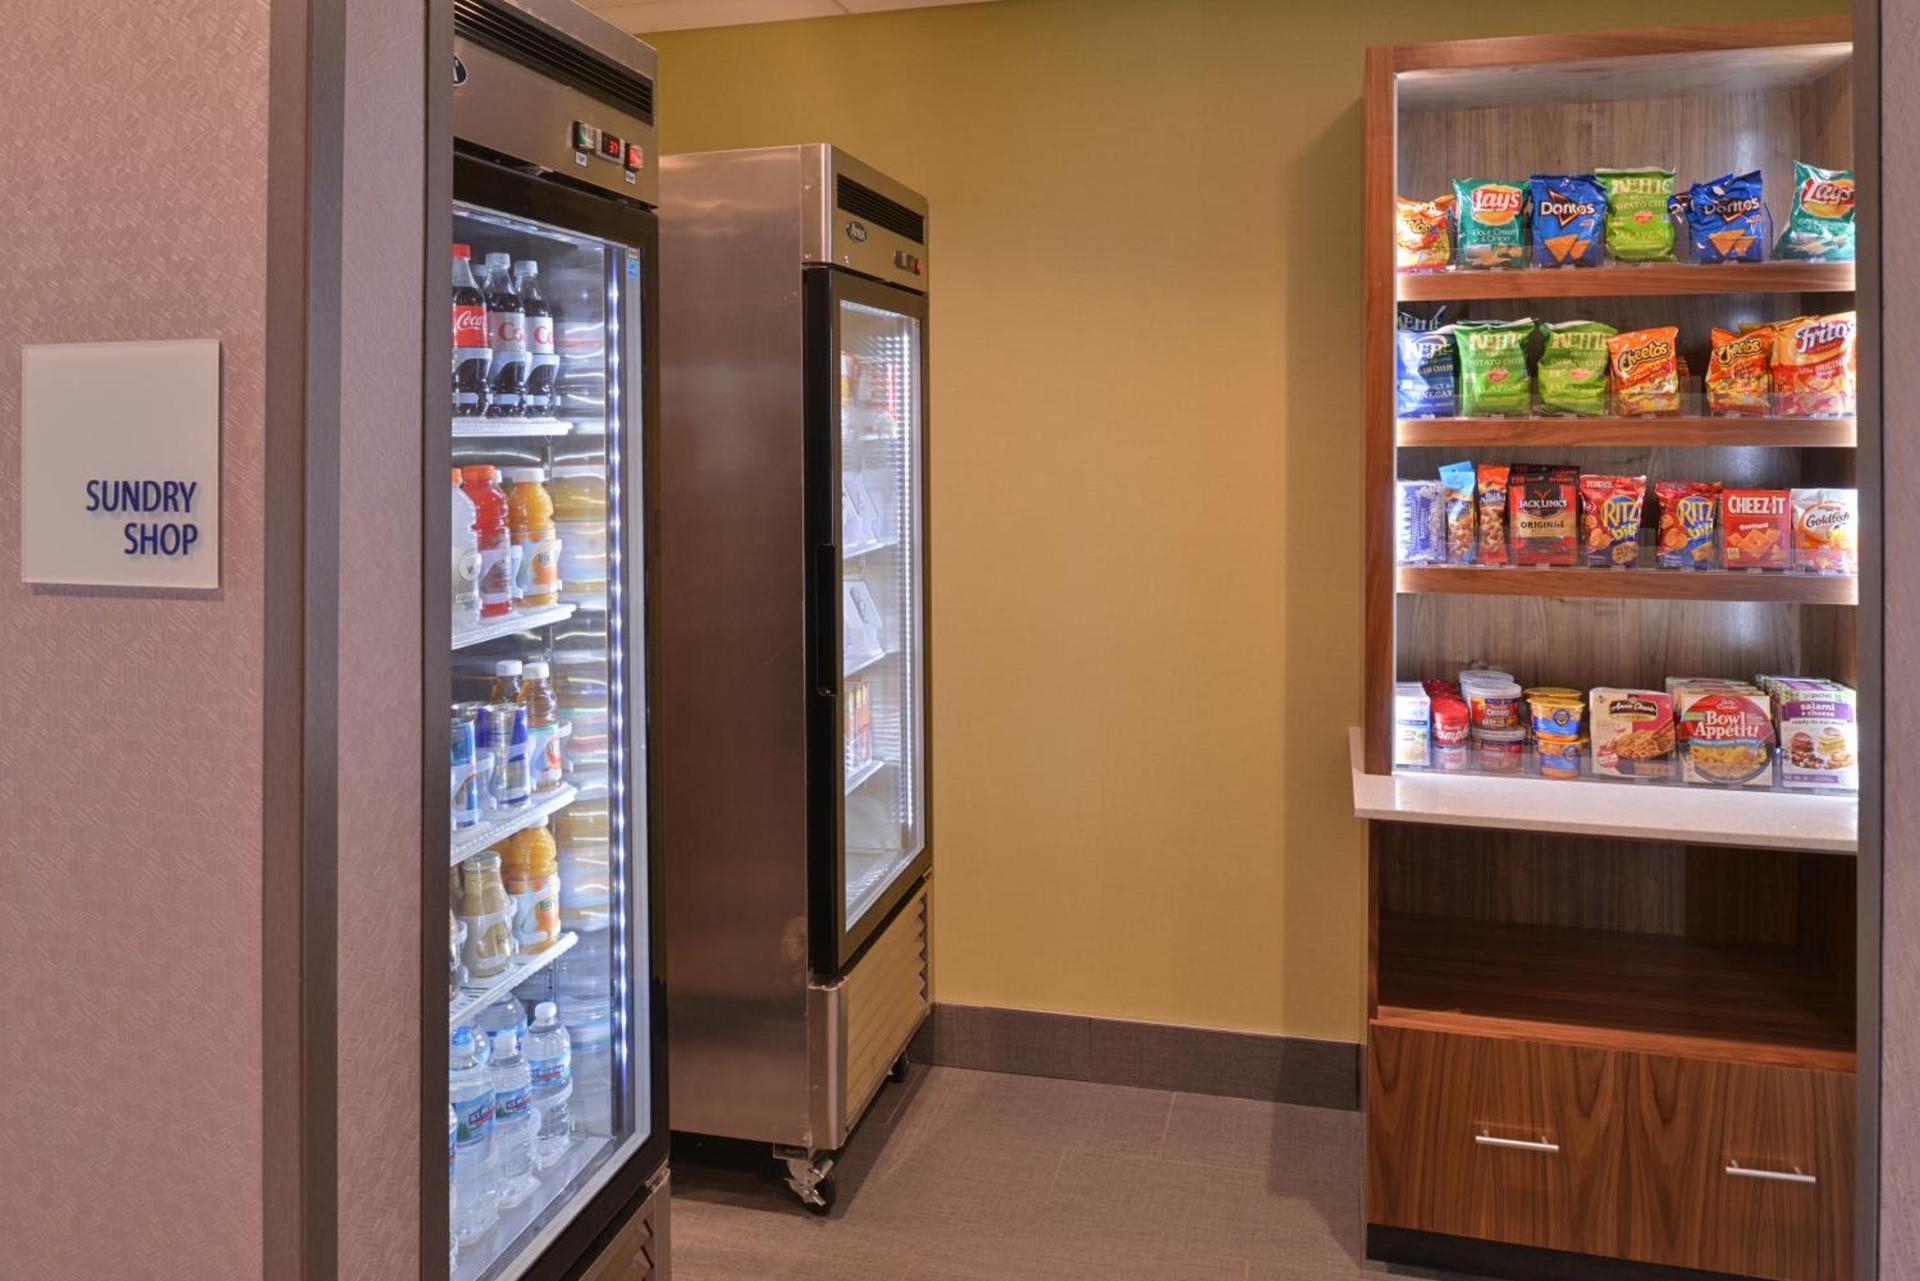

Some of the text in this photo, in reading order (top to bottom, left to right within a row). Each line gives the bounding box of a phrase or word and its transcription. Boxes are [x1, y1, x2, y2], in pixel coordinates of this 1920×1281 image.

[1541, 201, 1595, 216] Doritos
[1704, 197, 1760, 215] Doritos
[1618, 340, 1674, 373] Cheetos
[1717, 338, 1763, 367] Cheetos
[86, 479, 197, 513] SUNDRY
[1519, 500, 1541, 509] JACK
[1603, 501, 1641, 528] RITZ
[1679, 500, 1714, 526] RITZ
[1806, 511, 1850, 529] Goldfish
[124, 522, 198, 555] SHOP
[1706, 711, 1746, 726] Bowl
[1800, 703, 1836, 712] salami
